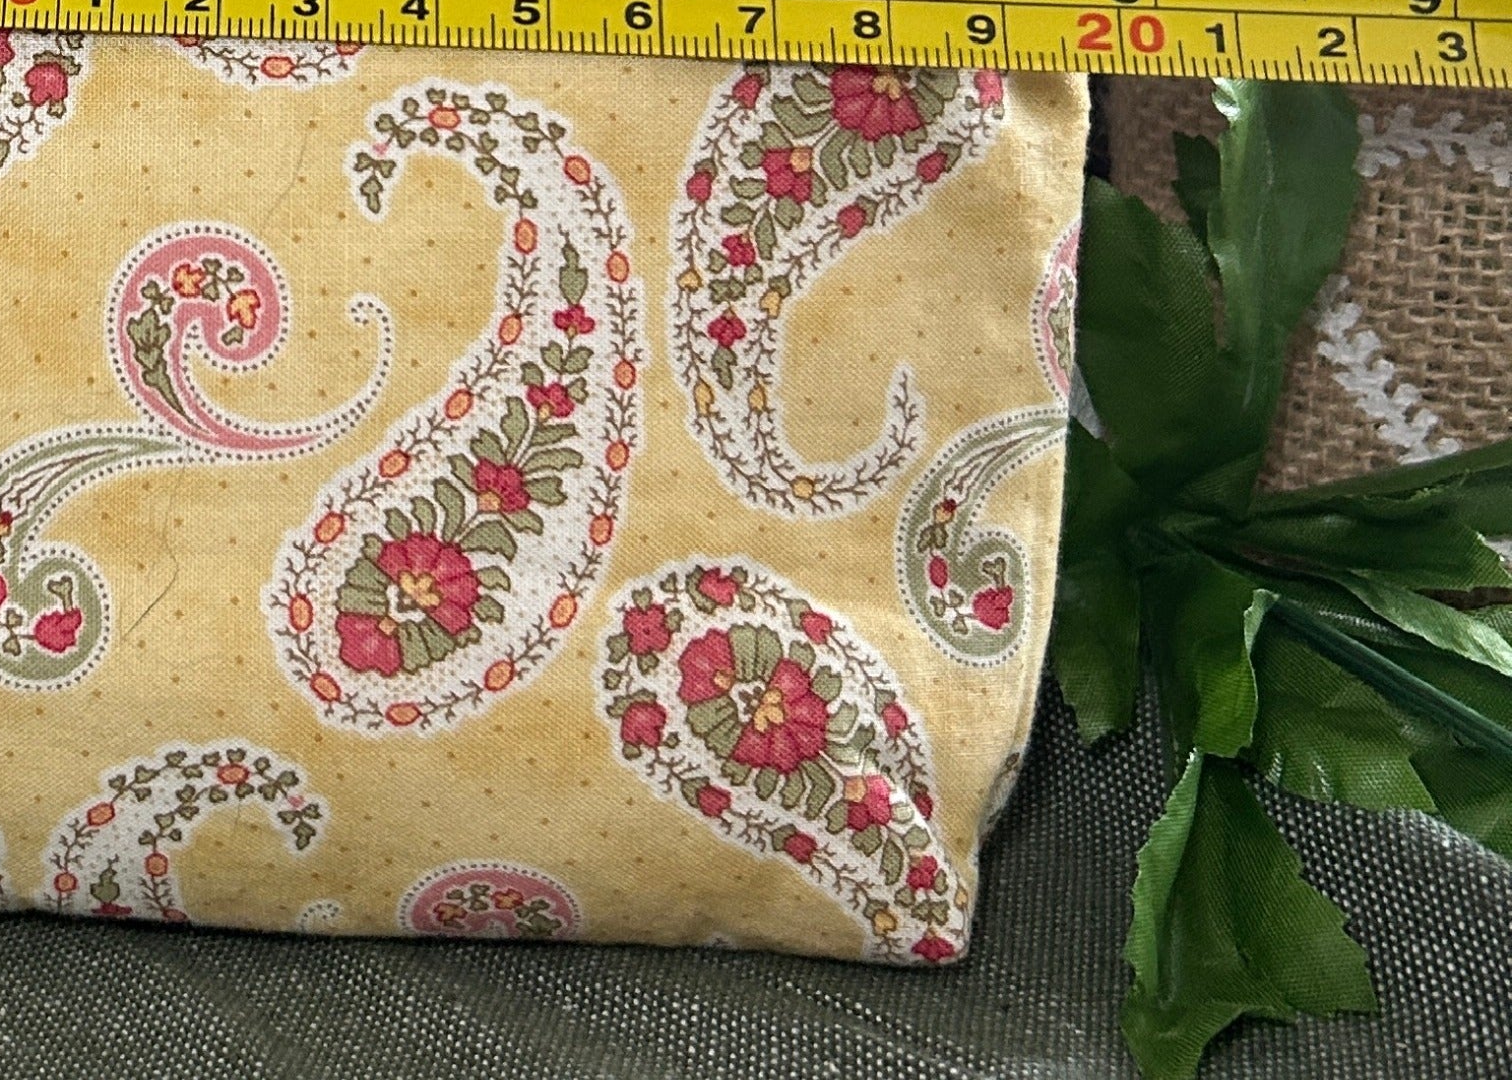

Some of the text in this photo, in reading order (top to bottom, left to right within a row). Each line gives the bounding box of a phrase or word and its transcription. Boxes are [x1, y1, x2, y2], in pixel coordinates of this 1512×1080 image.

[624, 0, 653, 29] 6
[737, 6, 766, 34] 7
[852, 10, 882, 39] 8
[967, 15, 997, 43] 9
[1077, 13, 1165, 53] 20
[1206, 24, 1225, 53] 1
[1317, 27, 1347, 57] 2
[1437, 31, 1468, 62] 3
